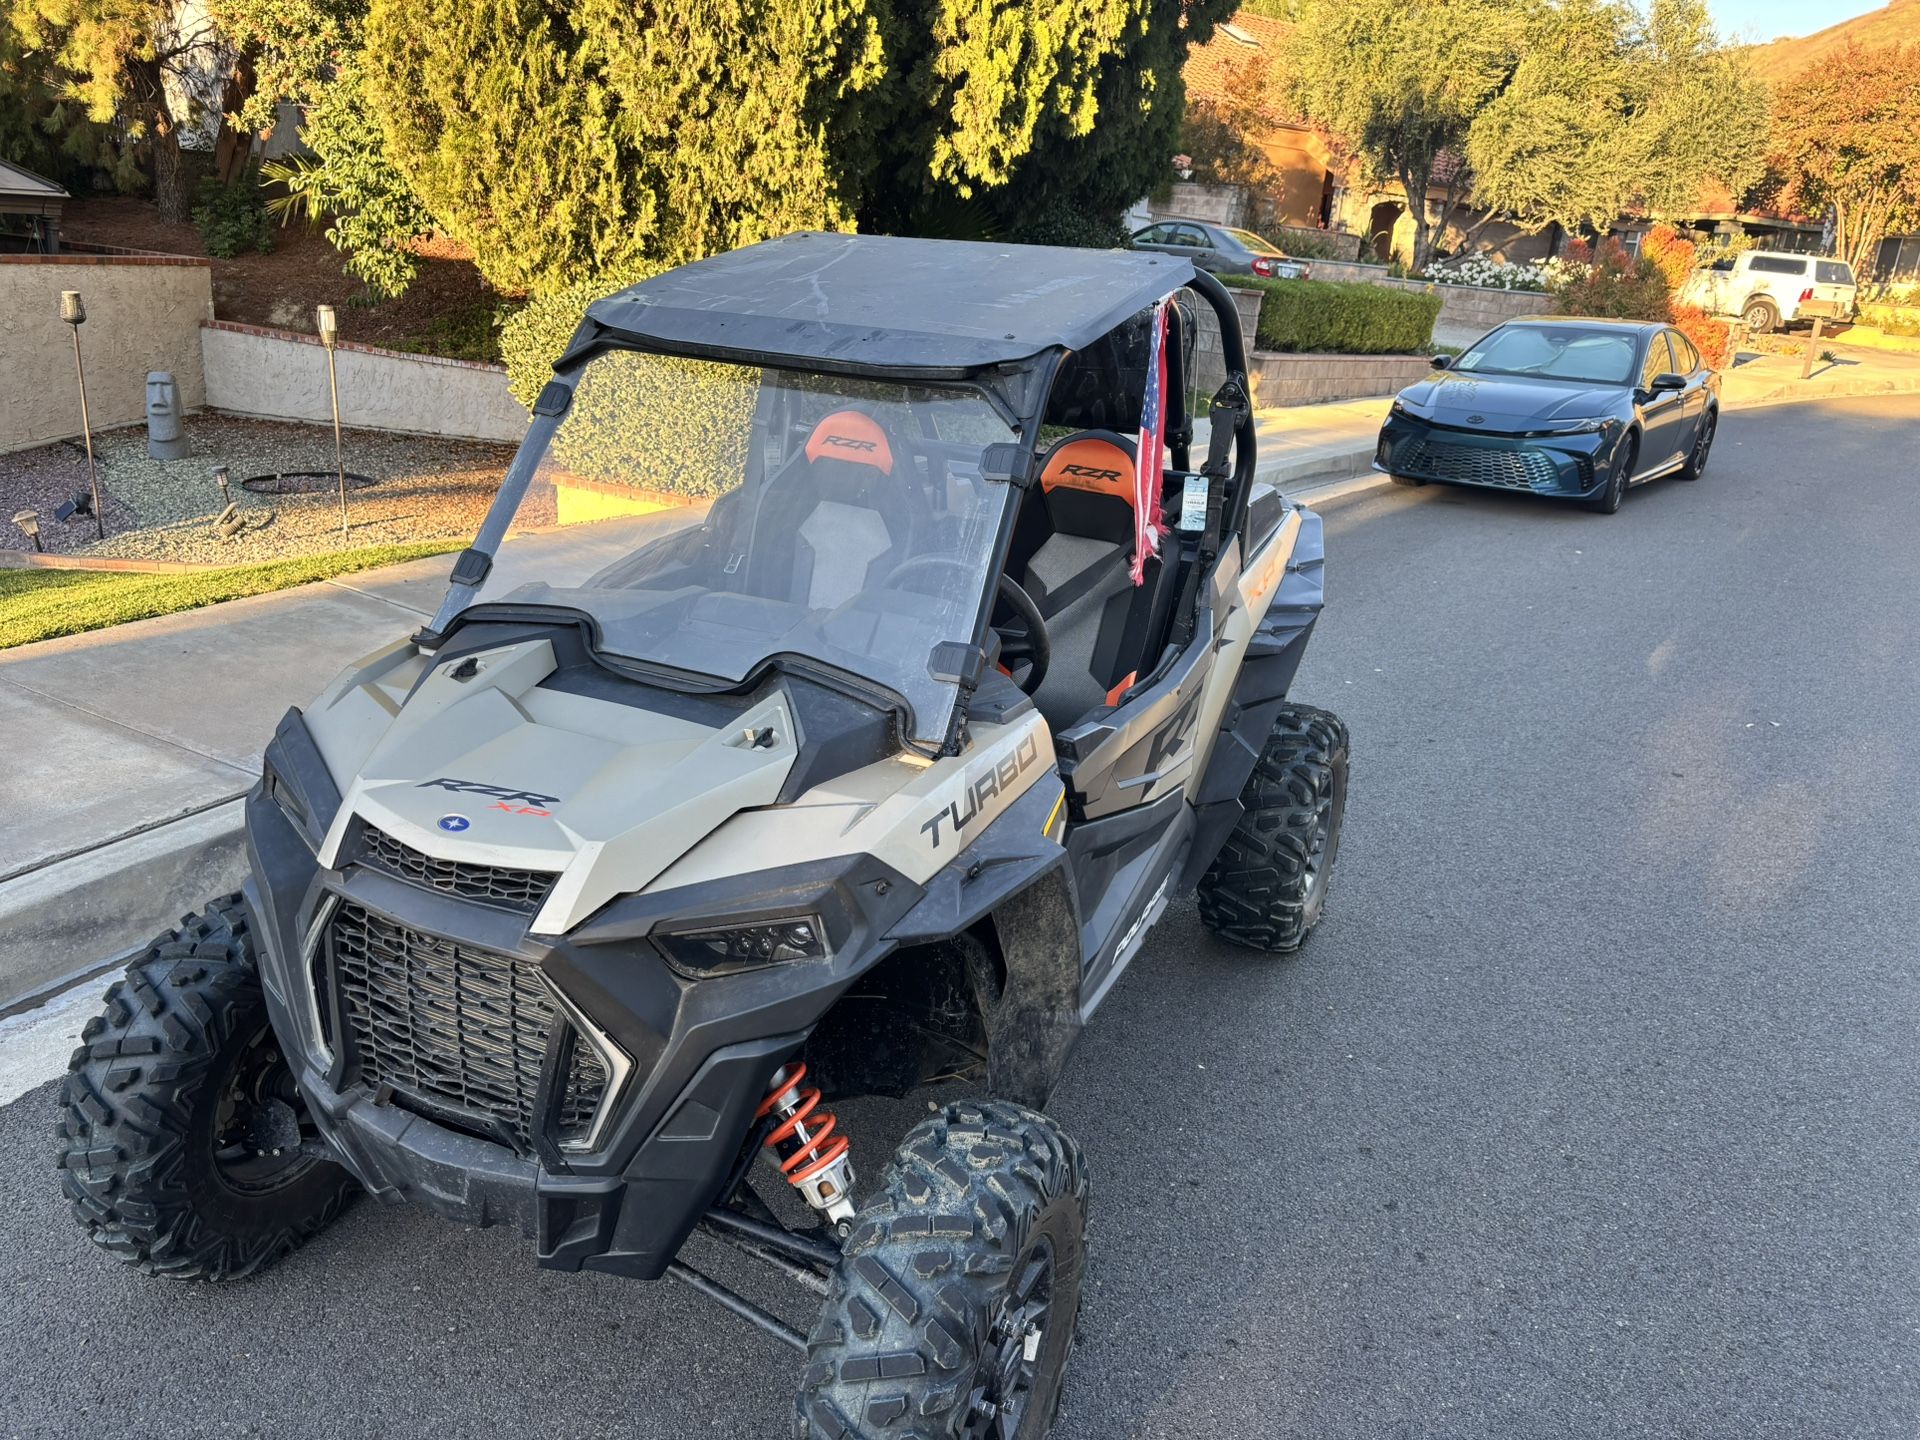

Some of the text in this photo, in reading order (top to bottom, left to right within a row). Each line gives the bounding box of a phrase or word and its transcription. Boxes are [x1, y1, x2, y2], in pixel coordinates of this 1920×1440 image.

[822, 435, 877, 452] RZR
[1059, 464, 1122, 482] RZR
[415, 778, 561, 808] RZR
[920, 732, 1038, 849] TURBO
[484, 801, 551, 817] XP
